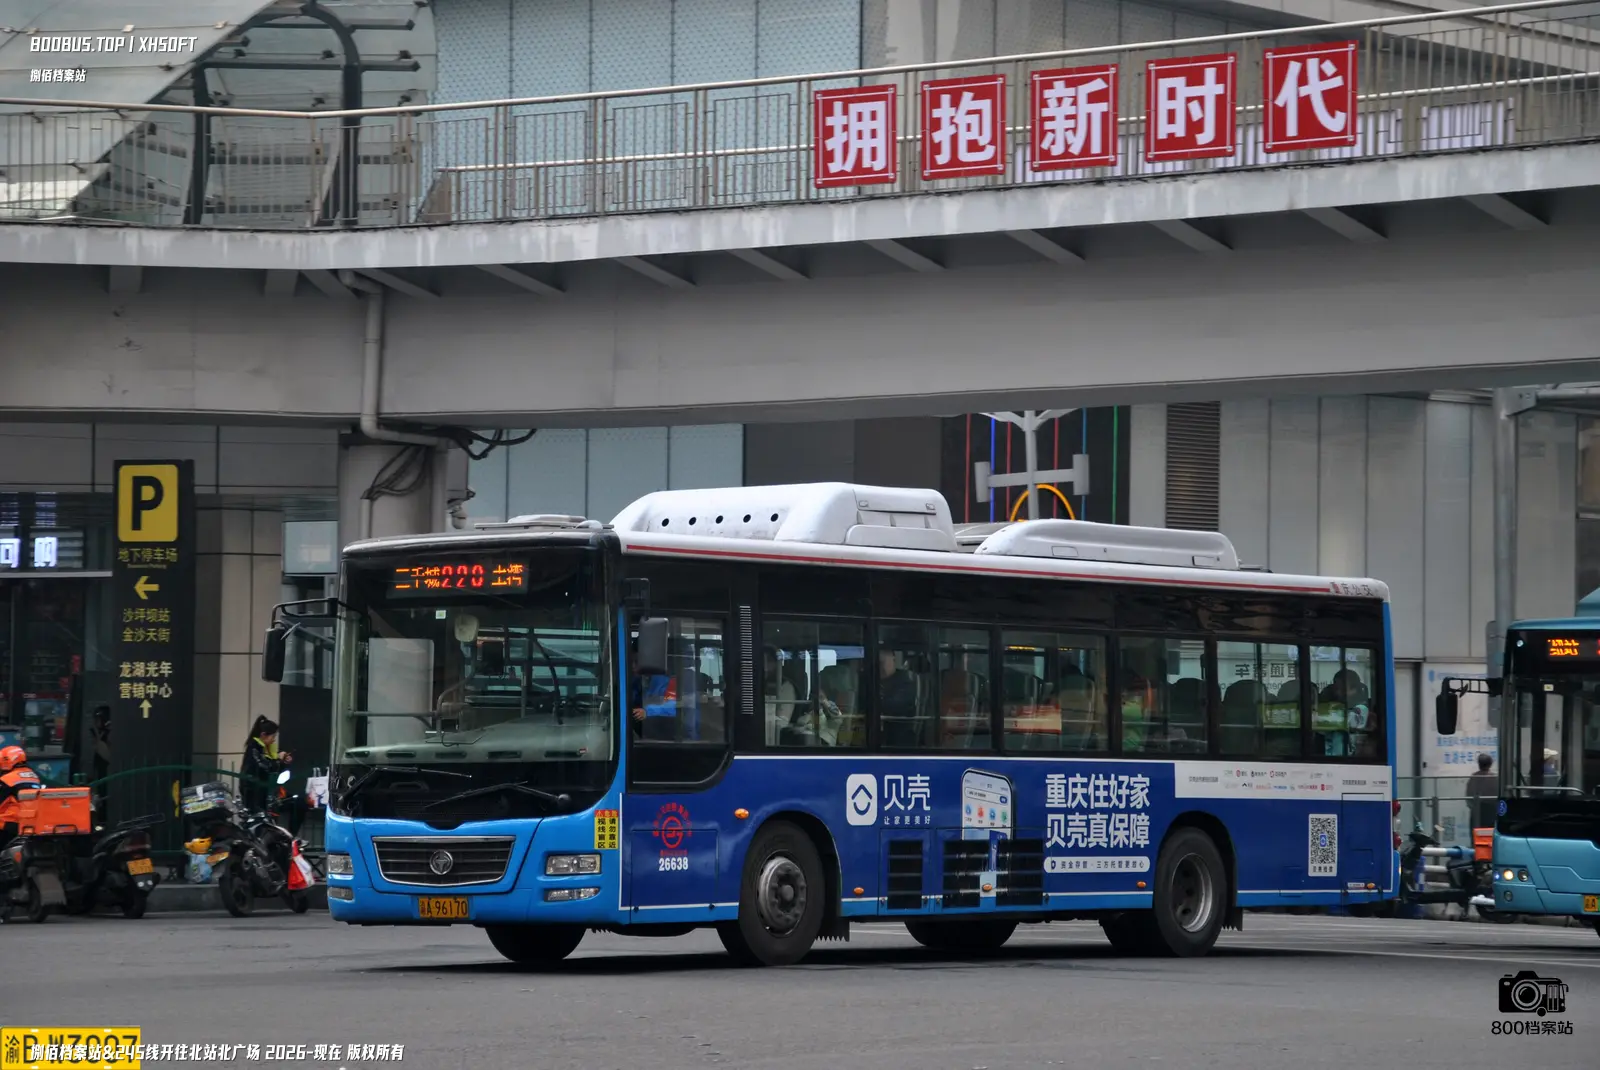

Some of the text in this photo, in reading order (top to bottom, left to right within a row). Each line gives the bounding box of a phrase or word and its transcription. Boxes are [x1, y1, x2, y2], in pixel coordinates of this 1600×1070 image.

[825, 57, 1347, 174] 拥抱新时代
[131, 475, 164, 531] P
[118, 548, 178, 562] 地下停车场
[122, 608, 171, 623] 沙坪坝站
[122, 628, 171, 642] 金沙天街
[119, 661, 173, 678] 龙湖光年
[119, 682, 173, 699] 营销中心
[884, 773, 931, 811] 贝壳
[1045, 773, 1151, 809] 重庆住好家
[883, 815, 931, 825] 让家更美好
[1045, 812, 1151, 849] 贝壳真保障
[658, 856, 689, 872] 26638
